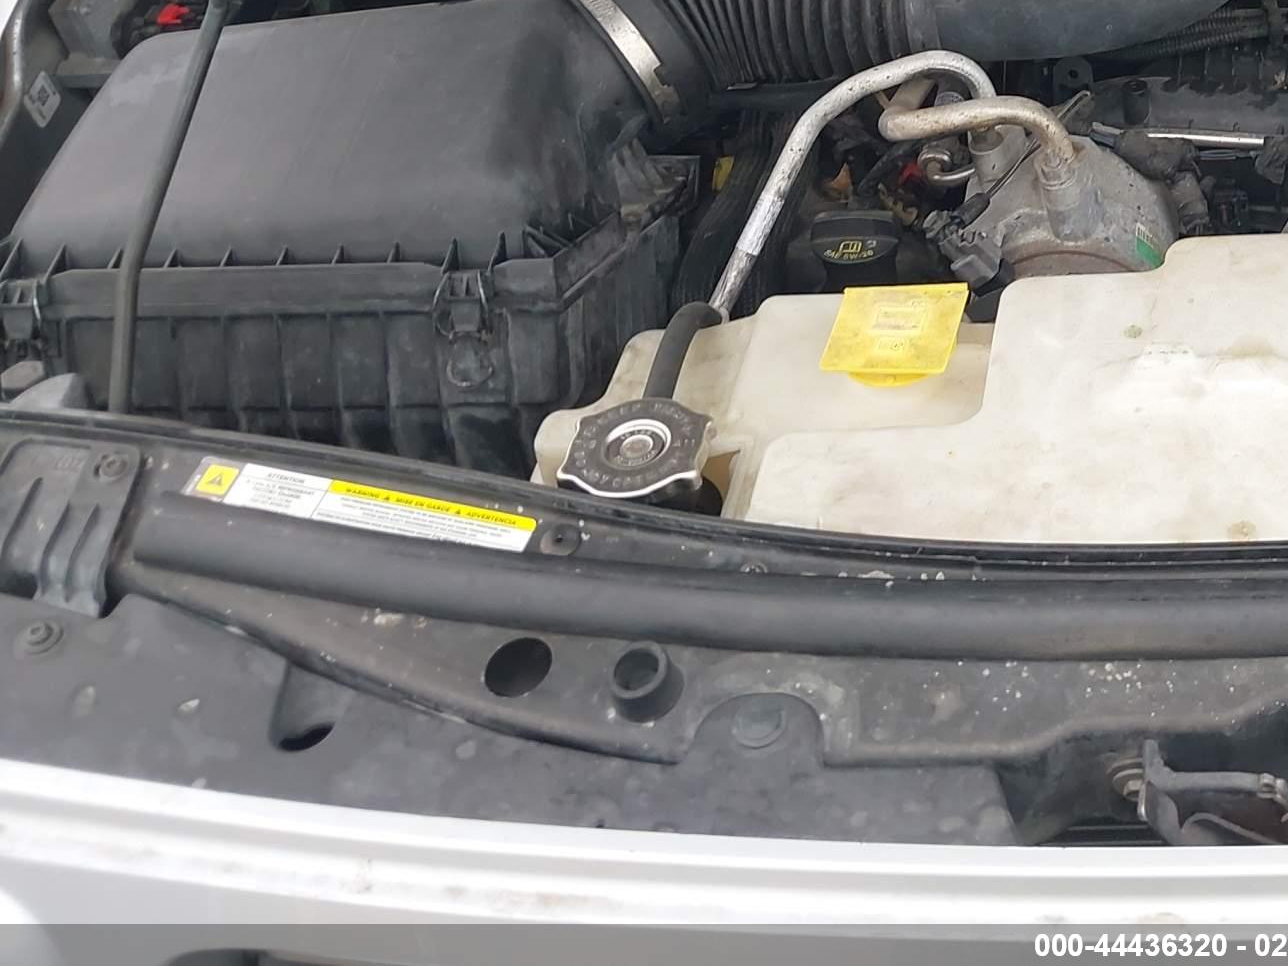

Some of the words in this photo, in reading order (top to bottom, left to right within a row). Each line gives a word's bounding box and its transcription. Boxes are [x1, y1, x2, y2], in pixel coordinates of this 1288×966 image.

[267, 472, 305, 484] ATTENTION
[345, 487, 380, 499] WARNING
[395, 497, 413, 505] MISE
[427, 502, 450, 512] GARDE
[467, 511, 517, 526] ADVERTENCIA
